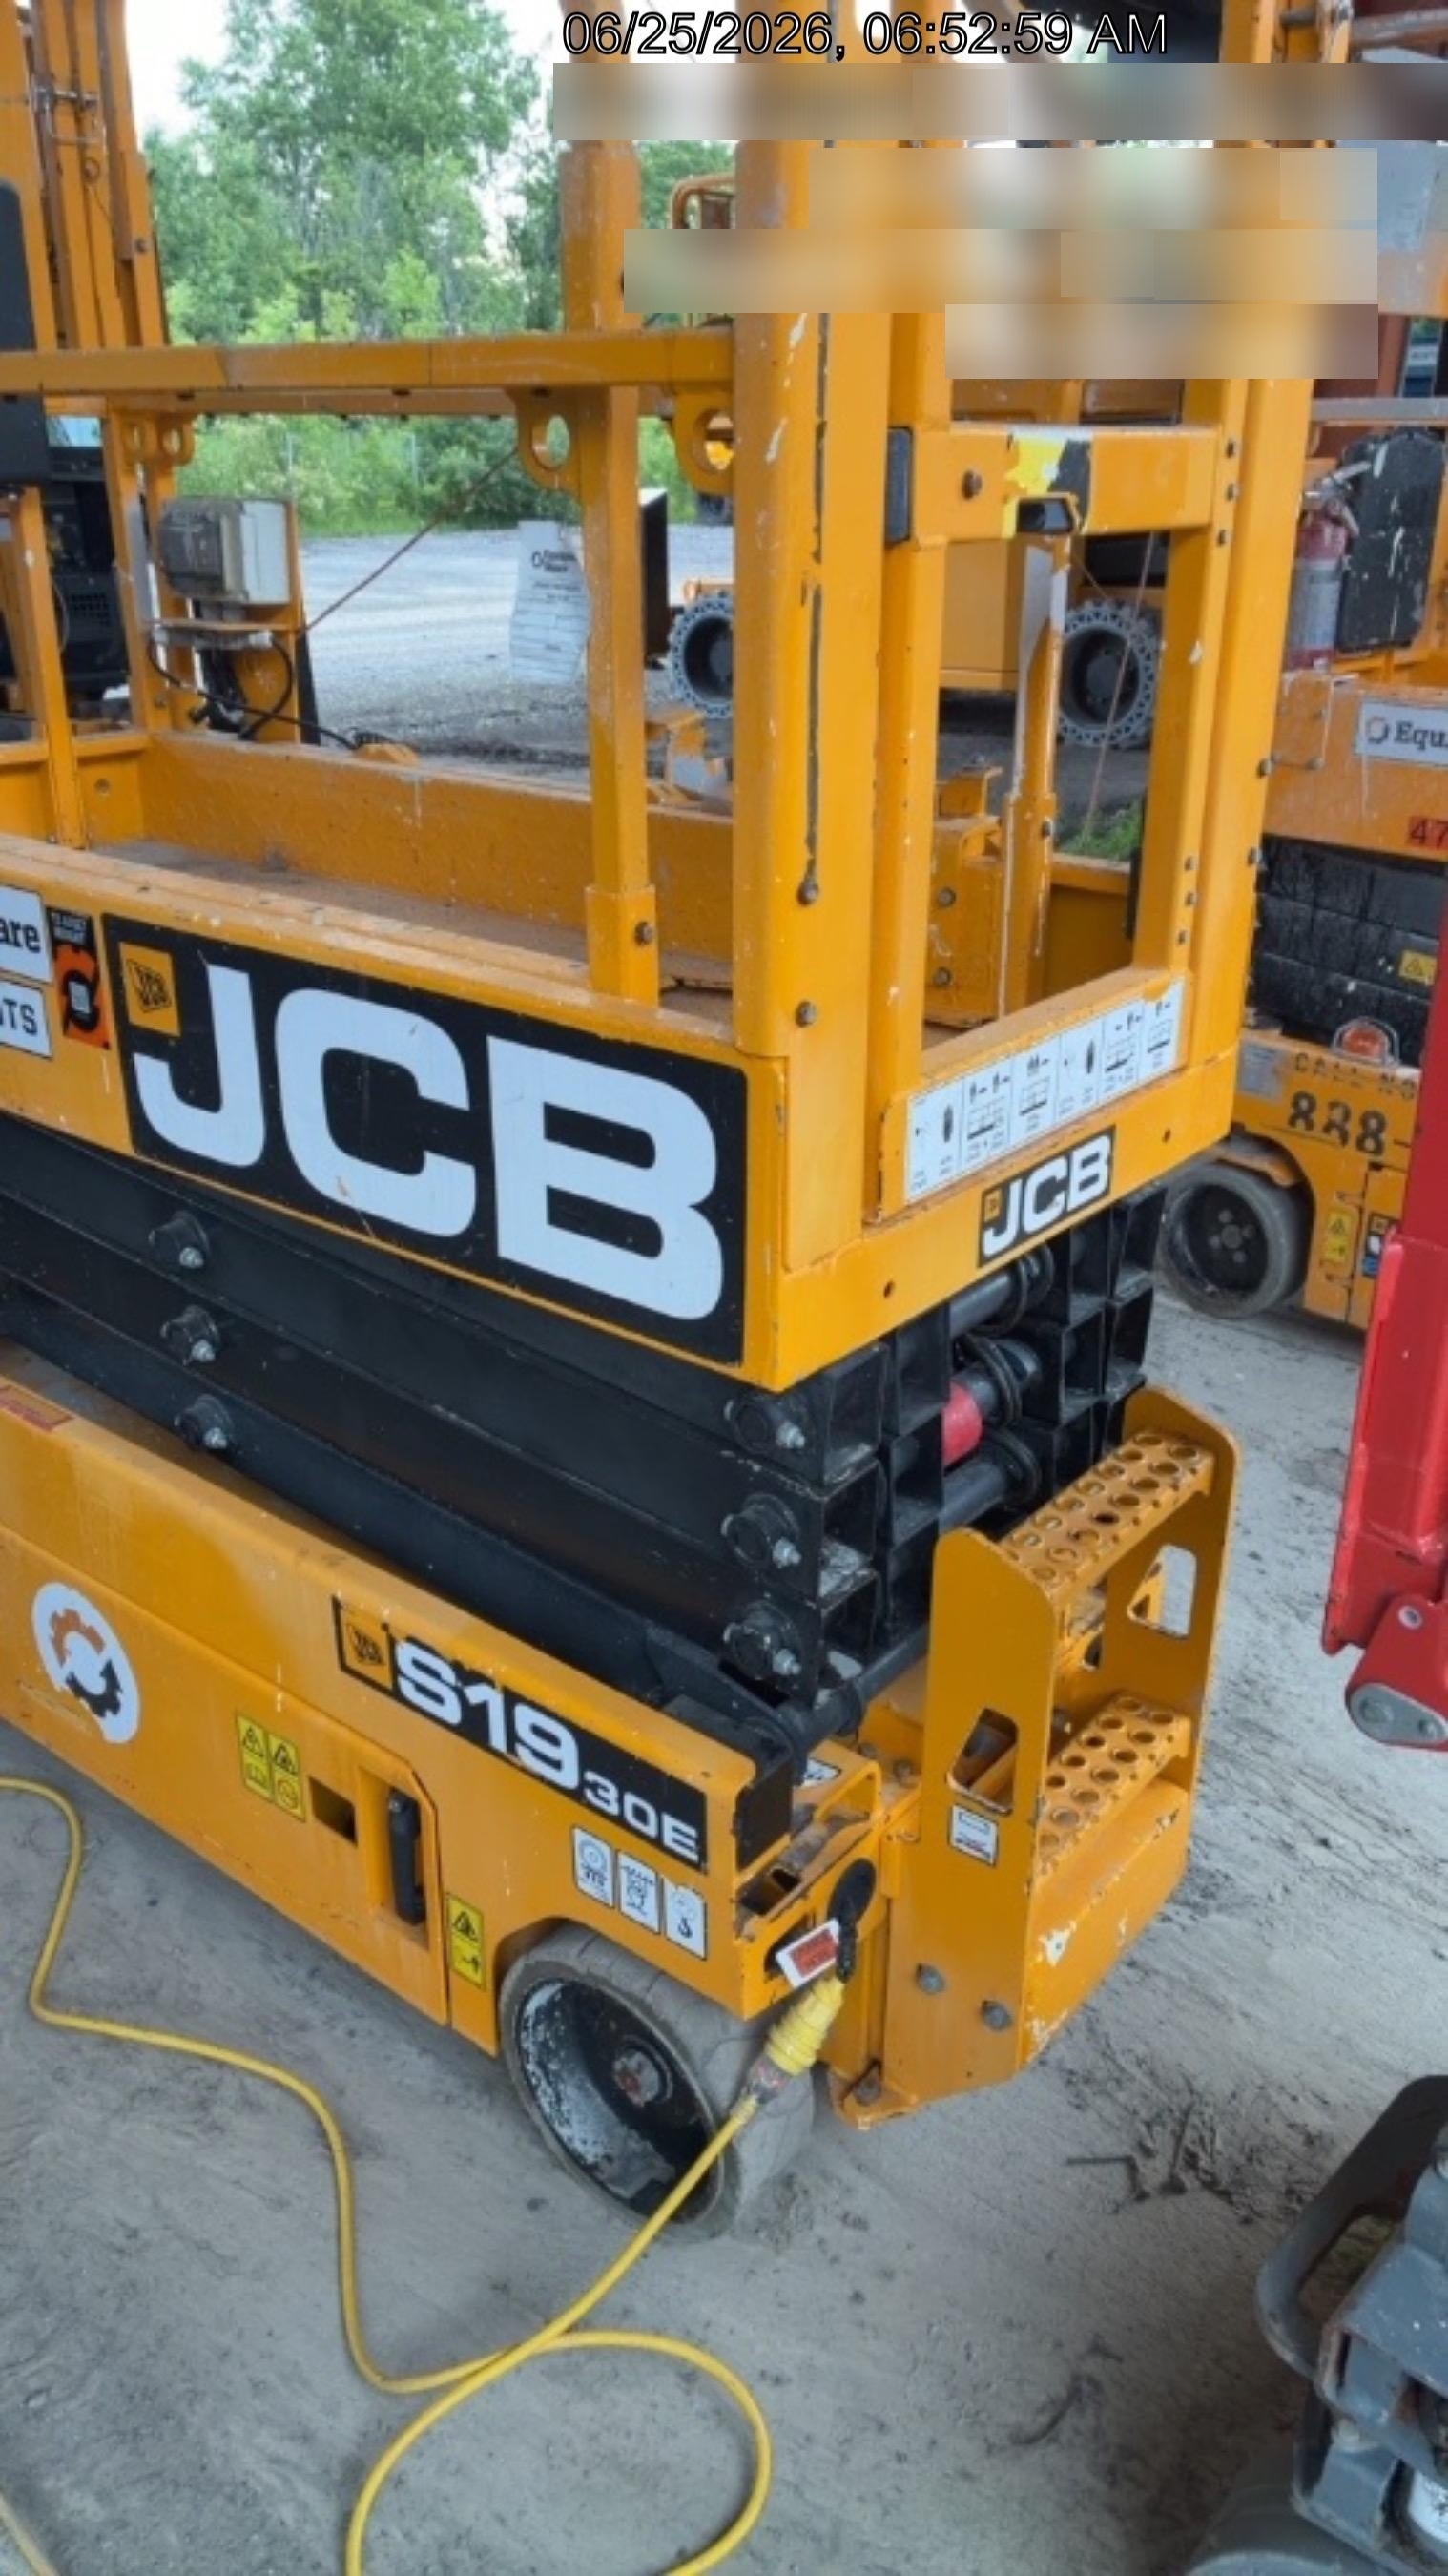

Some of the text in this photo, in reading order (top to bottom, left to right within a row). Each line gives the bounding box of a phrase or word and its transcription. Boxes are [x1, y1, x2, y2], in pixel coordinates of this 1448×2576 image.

[0, 998, 37, 1033] TS
[133, 964, 722, 1320] JCB
[983, 1135, 1111, 1257] JCB
